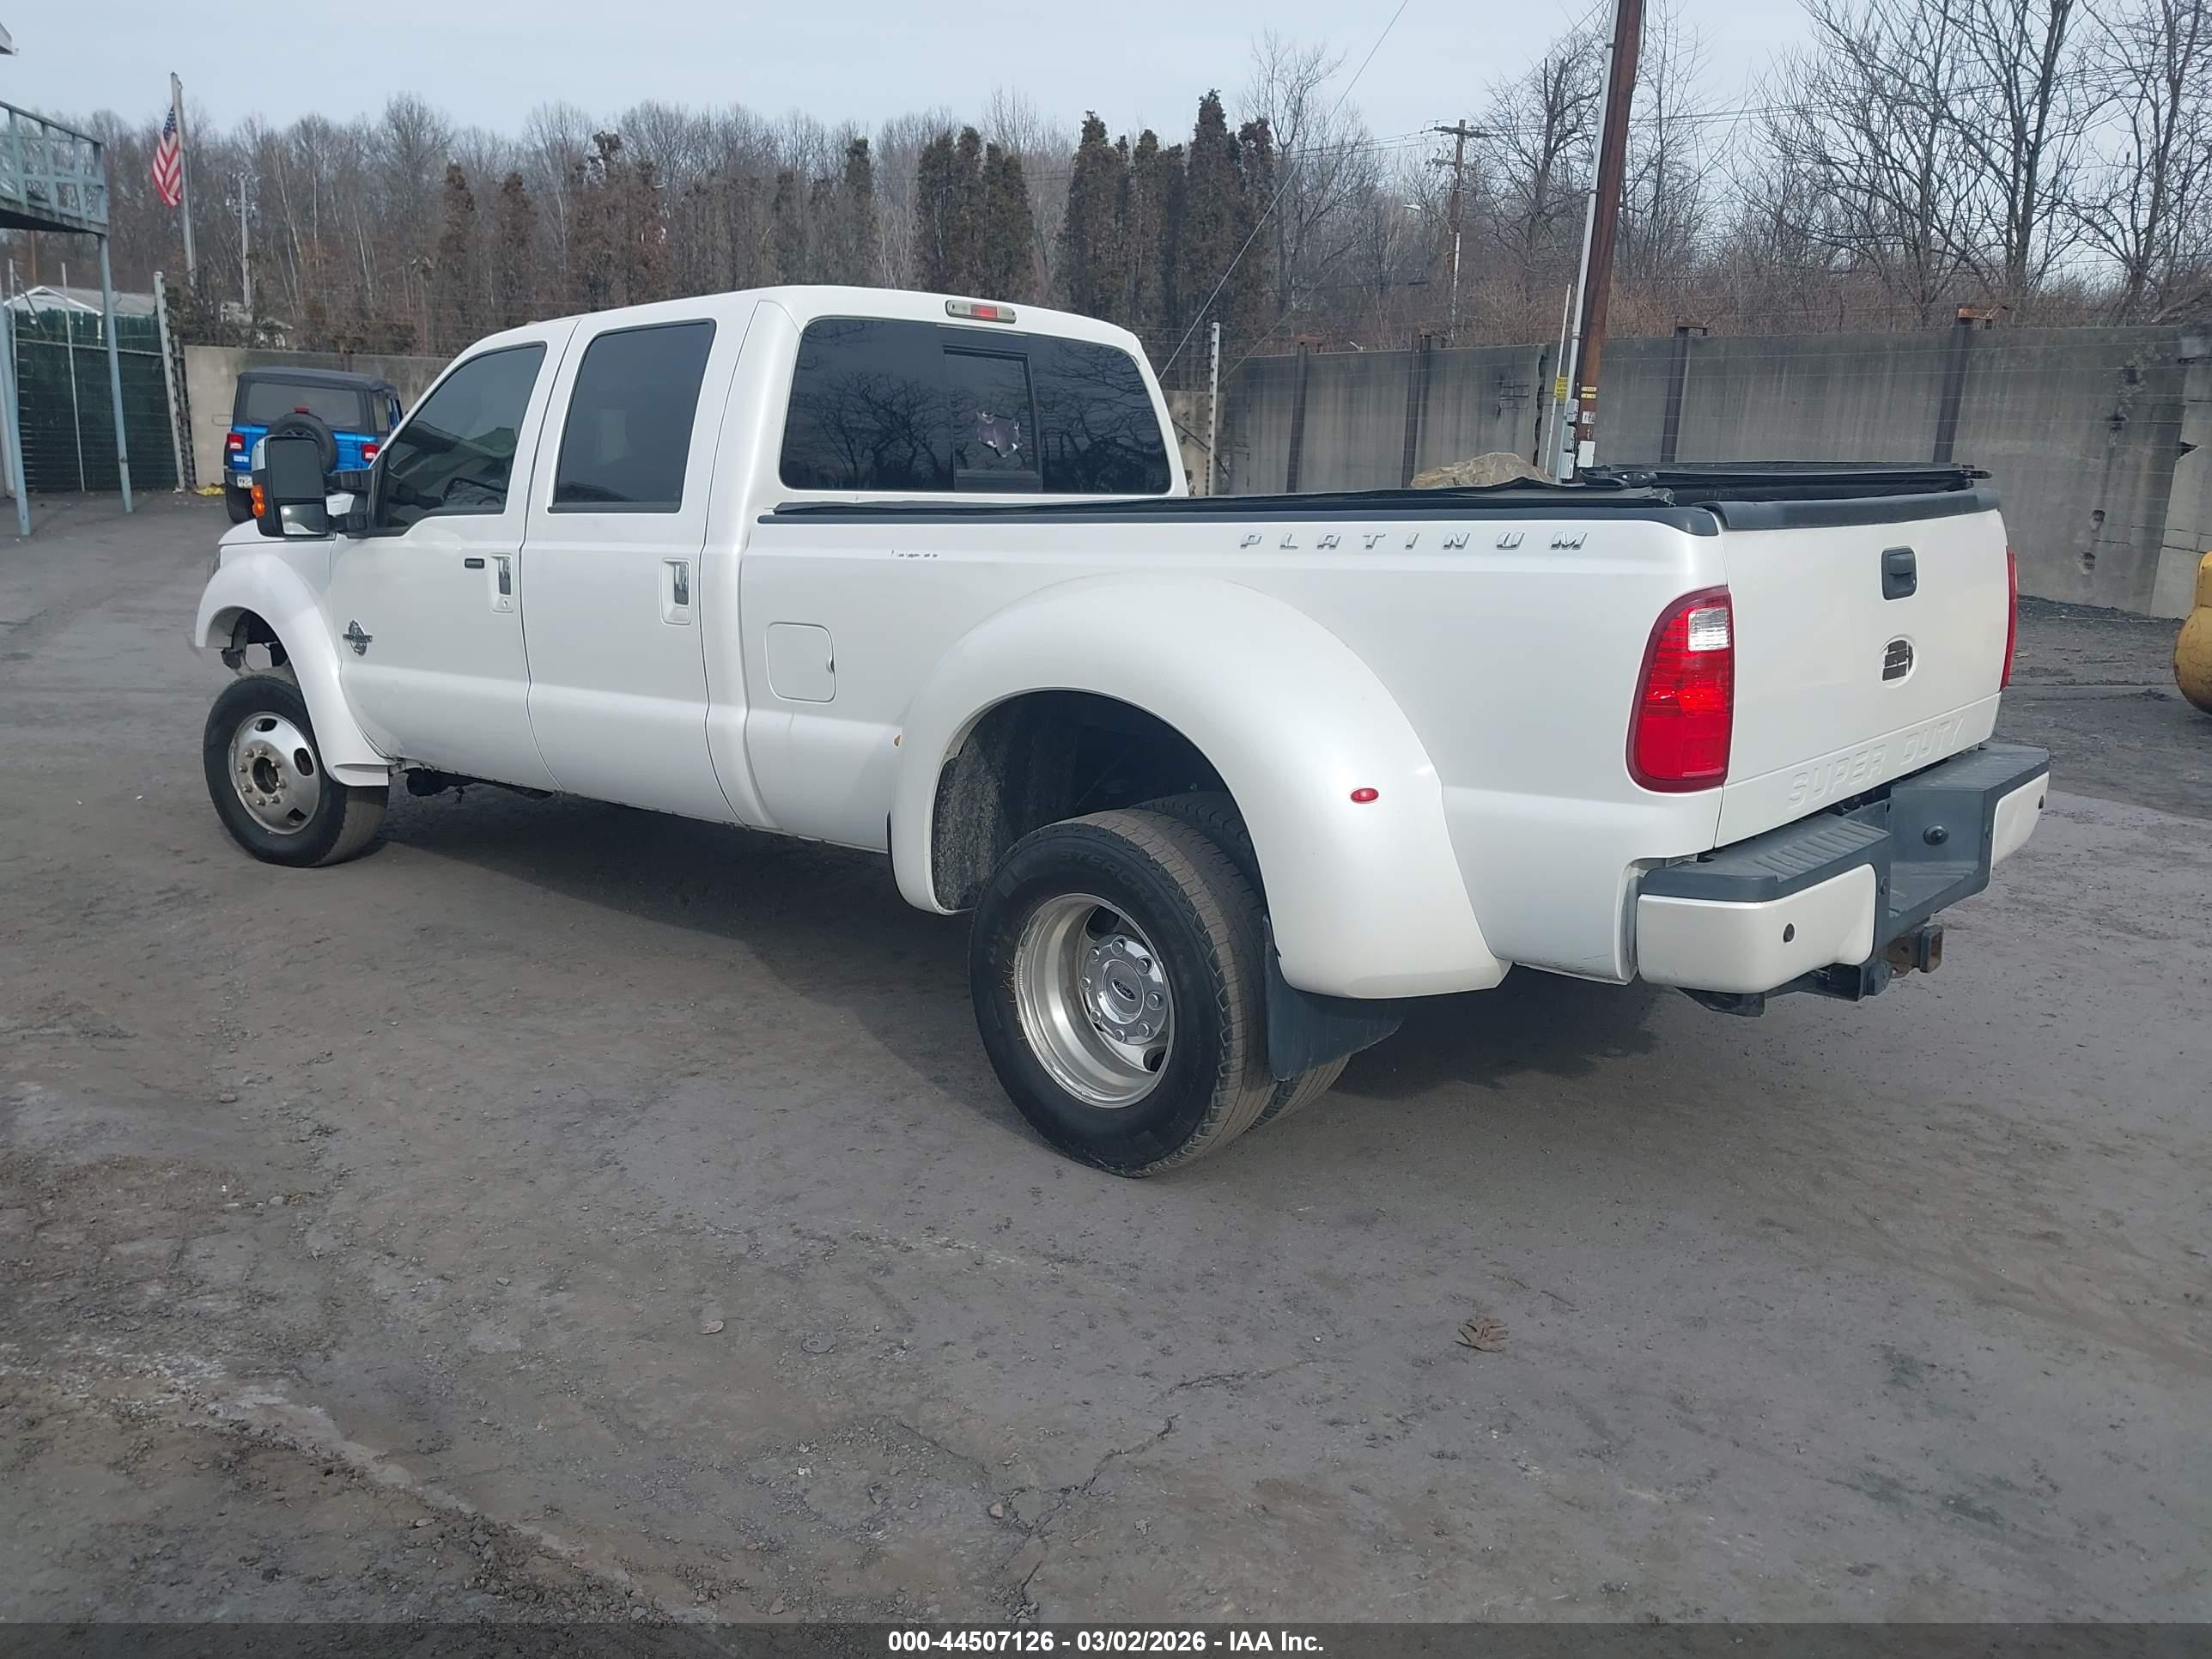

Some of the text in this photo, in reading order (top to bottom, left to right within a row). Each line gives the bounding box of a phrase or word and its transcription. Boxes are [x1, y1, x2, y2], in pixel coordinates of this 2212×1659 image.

[1239, 531, 1589, 550] PLATINUM
[1786, 715, 1965, 811] SUPER DUTY
